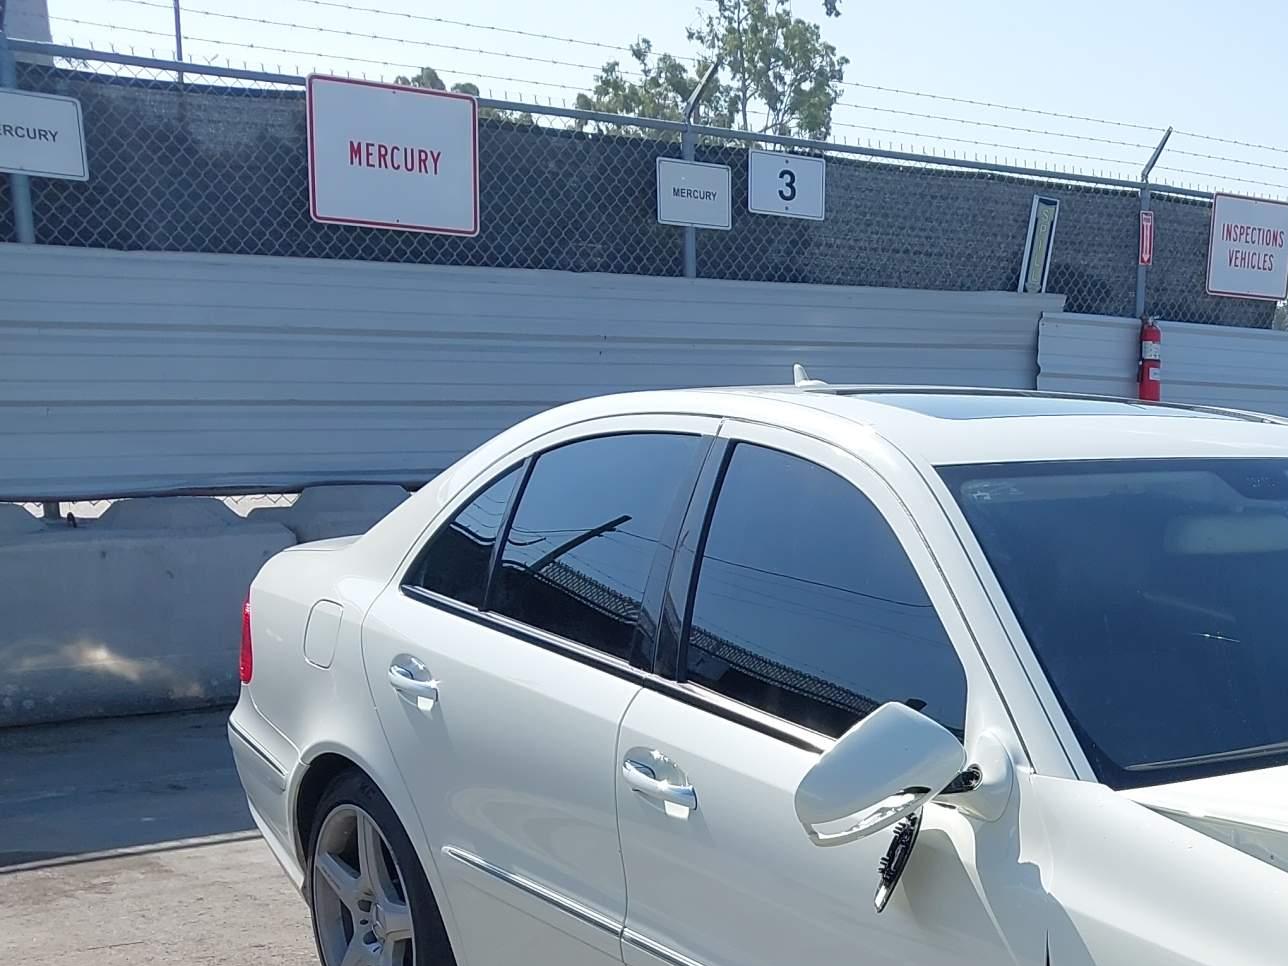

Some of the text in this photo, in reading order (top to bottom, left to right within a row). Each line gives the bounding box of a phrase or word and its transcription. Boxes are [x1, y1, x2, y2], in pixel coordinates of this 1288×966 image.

[0, 124, 58, 143] RCURY
[349, 140, 442, 175] MERCURY
[672, 187, 717, 201] MERCURY
[778, 169, 797, 202] 3
[1221, 223, 1285, 249] INSPECTIONS
[1228, 248, 1274, 272] VEHICLES
